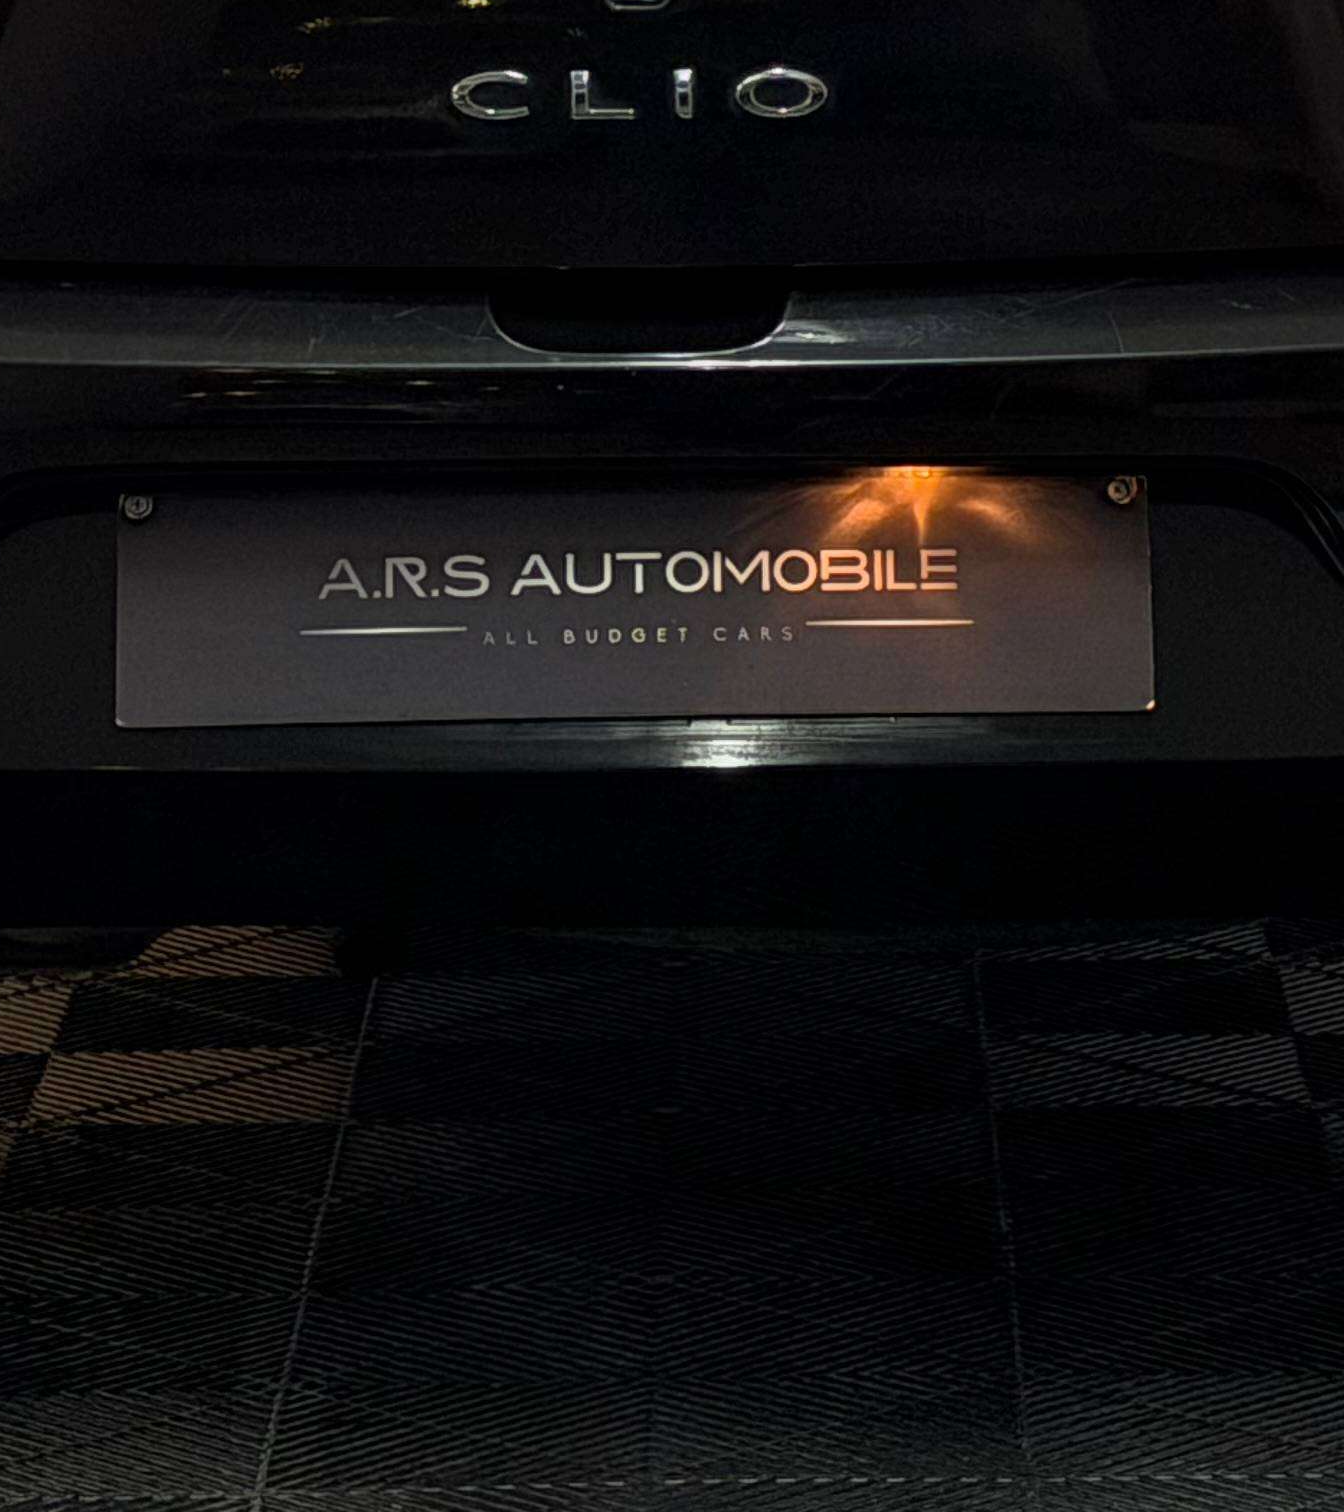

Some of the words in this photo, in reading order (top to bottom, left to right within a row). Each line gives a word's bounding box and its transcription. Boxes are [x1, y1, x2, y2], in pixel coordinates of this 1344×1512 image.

[452, 68, 828, 120] CLIO
[319, 554, 490, 600] A.R.S
[510, 549, 958, 596] AUTOMOBILE
[483, 630, 538, 646] ALL
[563, 626, 689, 645] BUDGET
[713, 626, 793, 643] CARS
